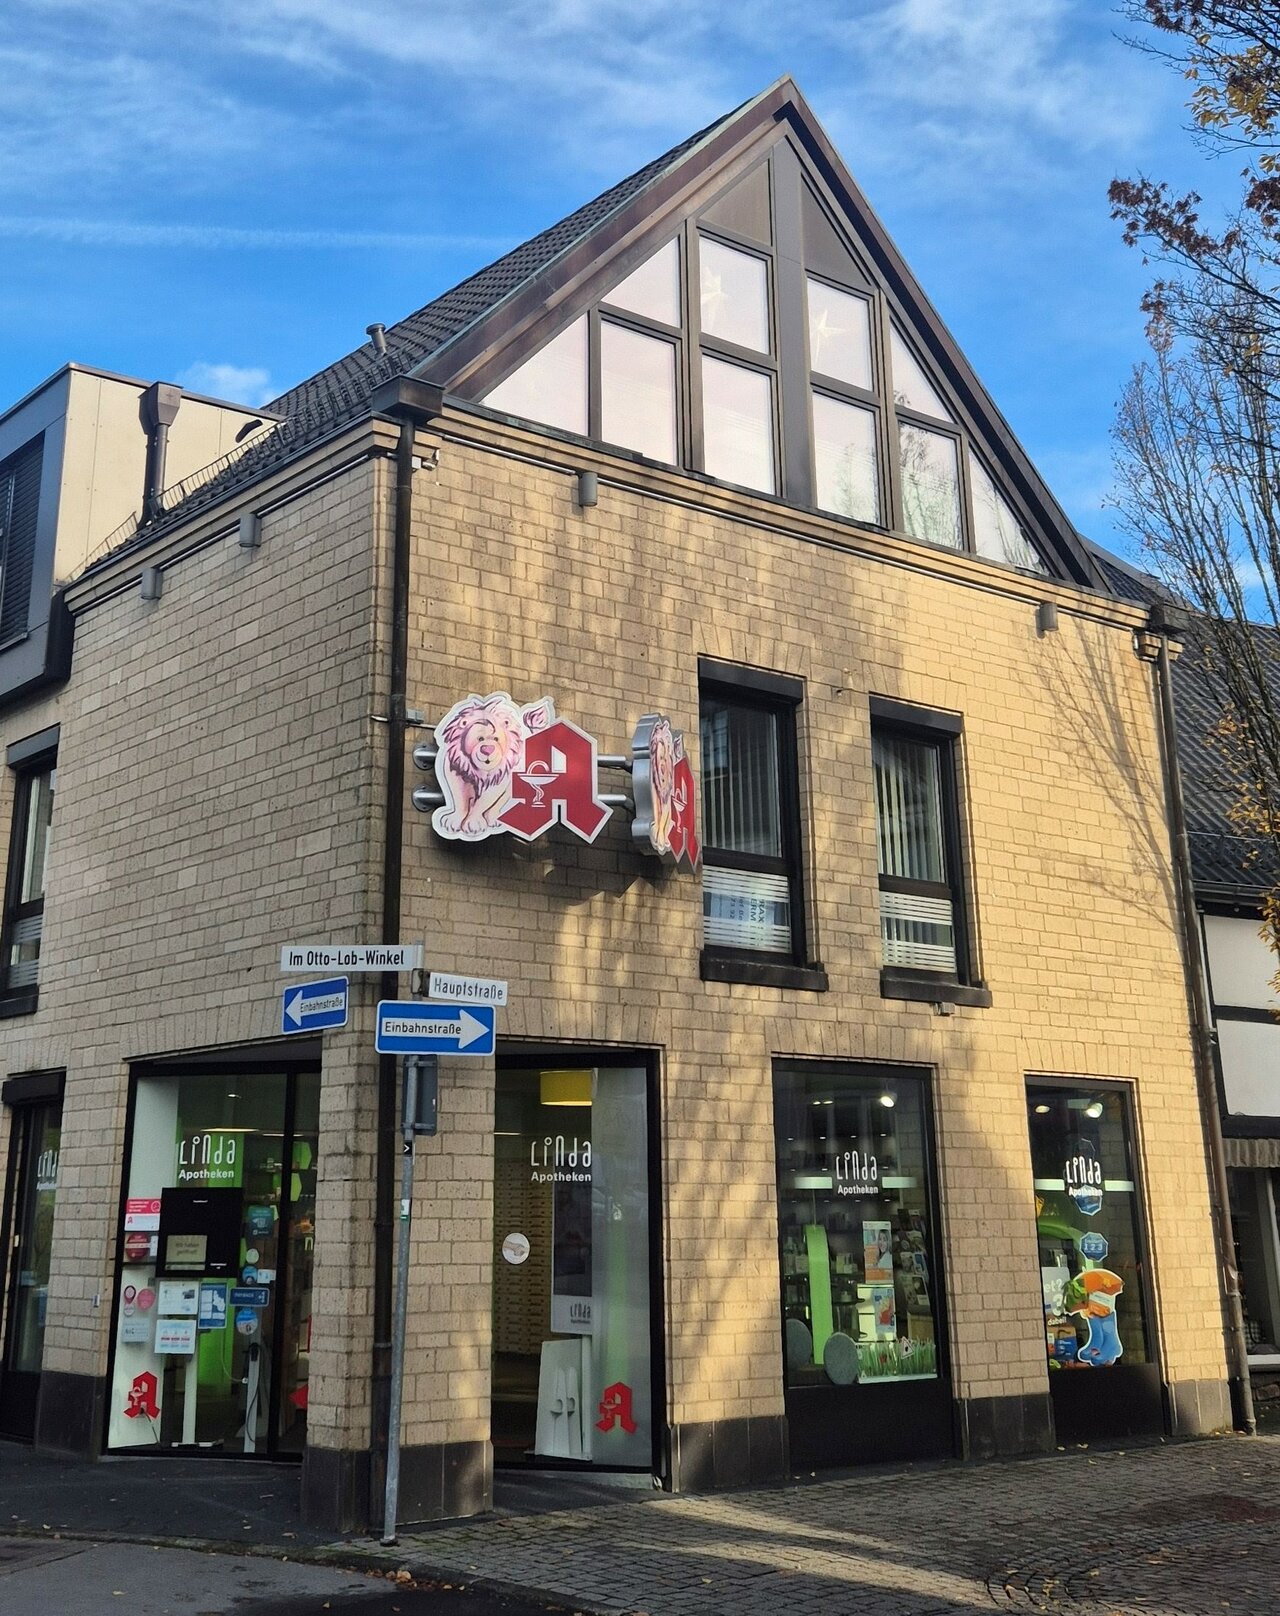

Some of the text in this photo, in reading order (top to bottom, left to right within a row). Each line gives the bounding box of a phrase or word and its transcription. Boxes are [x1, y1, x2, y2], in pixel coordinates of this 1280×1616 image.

[289, 950, 404, 966] Im Otto-Lob-Winkel
[433, 978, 504, 1000] Hauptstraße
[300, 997, 344, 1013] Einbahnstraße
[385, 1022, 462, 1035] Einbahnstraße
[178, 1169, 235, 1181] Apotheken
[531, 1171, 592, 1183] Apotheken
[838, 1185, 878, 1196] Apotheken
